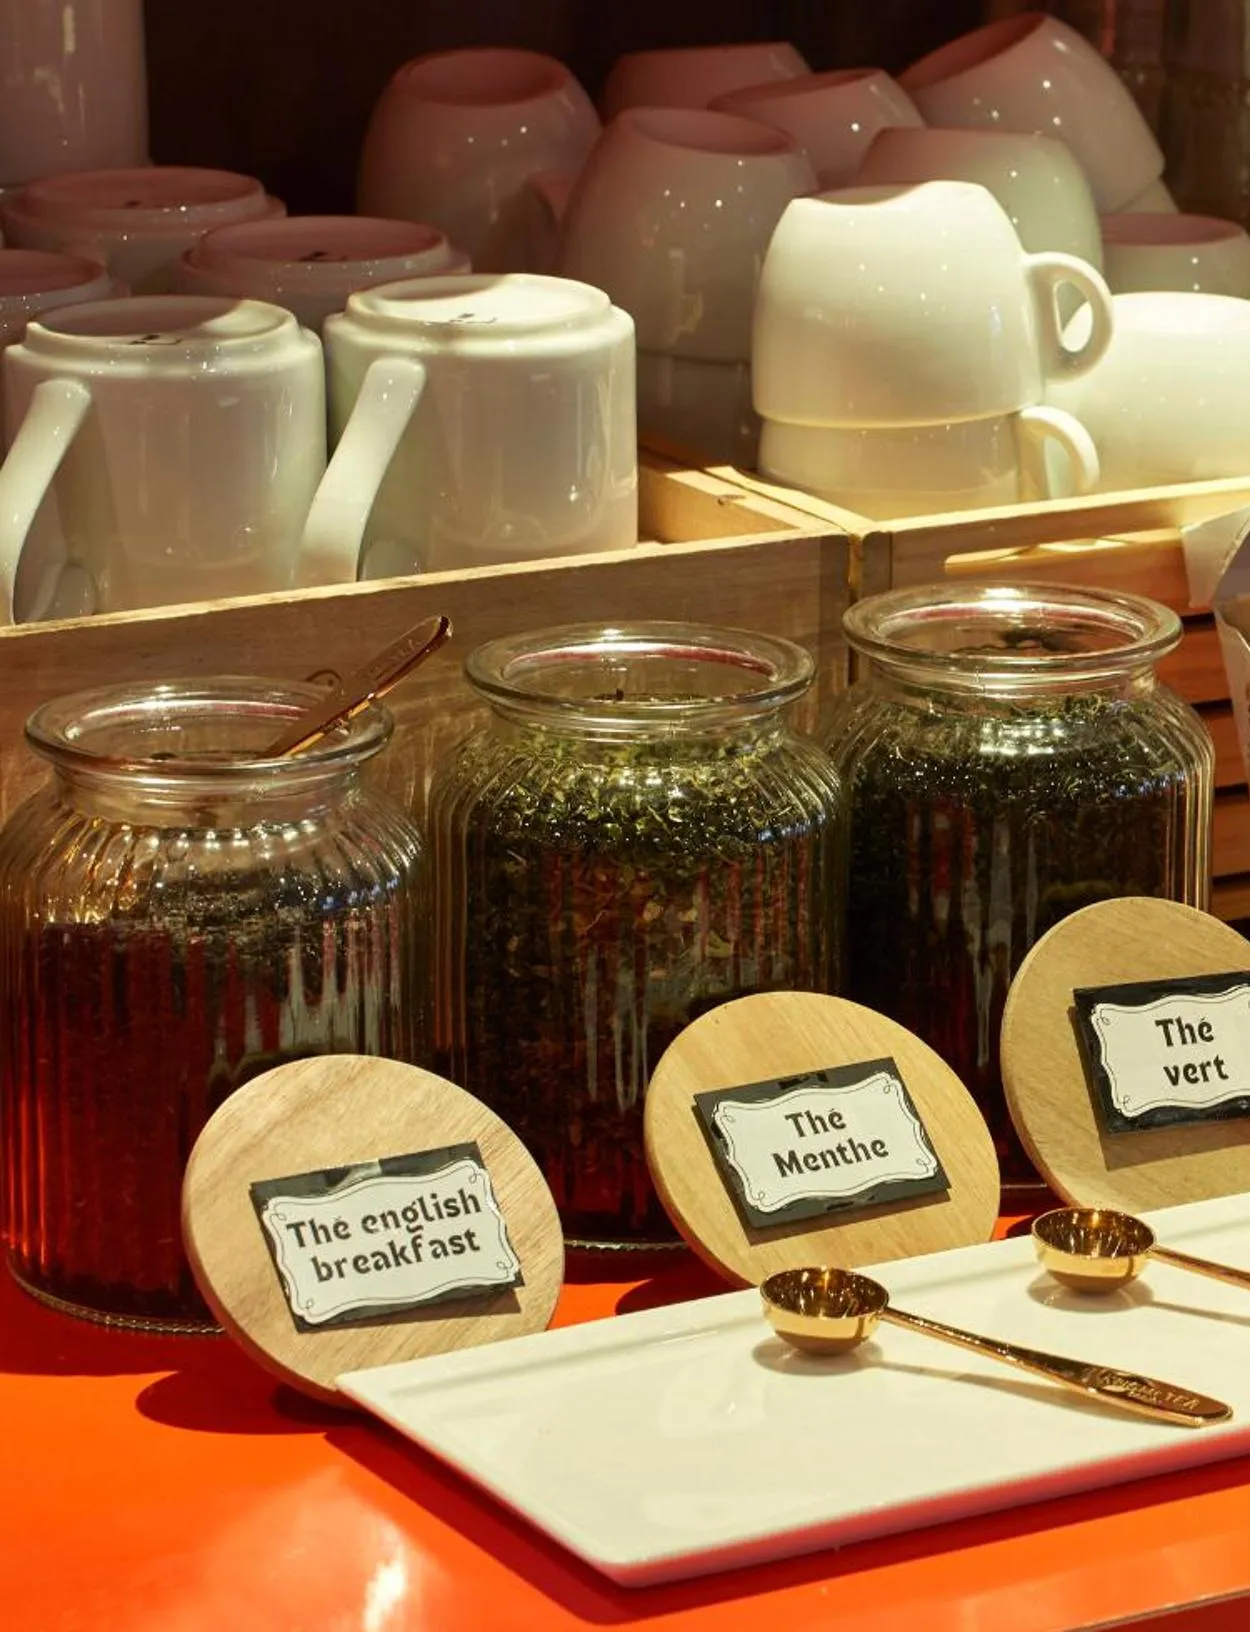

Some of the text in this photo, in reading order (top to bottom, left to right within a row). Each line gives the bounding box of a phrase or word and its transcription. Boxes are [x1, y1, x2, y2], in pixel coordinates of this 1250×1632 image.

[1155, 1016, 1214, 1047] Thé
[1163, 1054, 1229, 1086] vert
[785, 1107, 847, 1138] Thé
[772, 1138, 889, 1178] Menthe
[360, 1188, 482, 1234] english
[310, 1228, 481, 1283] breakfast
